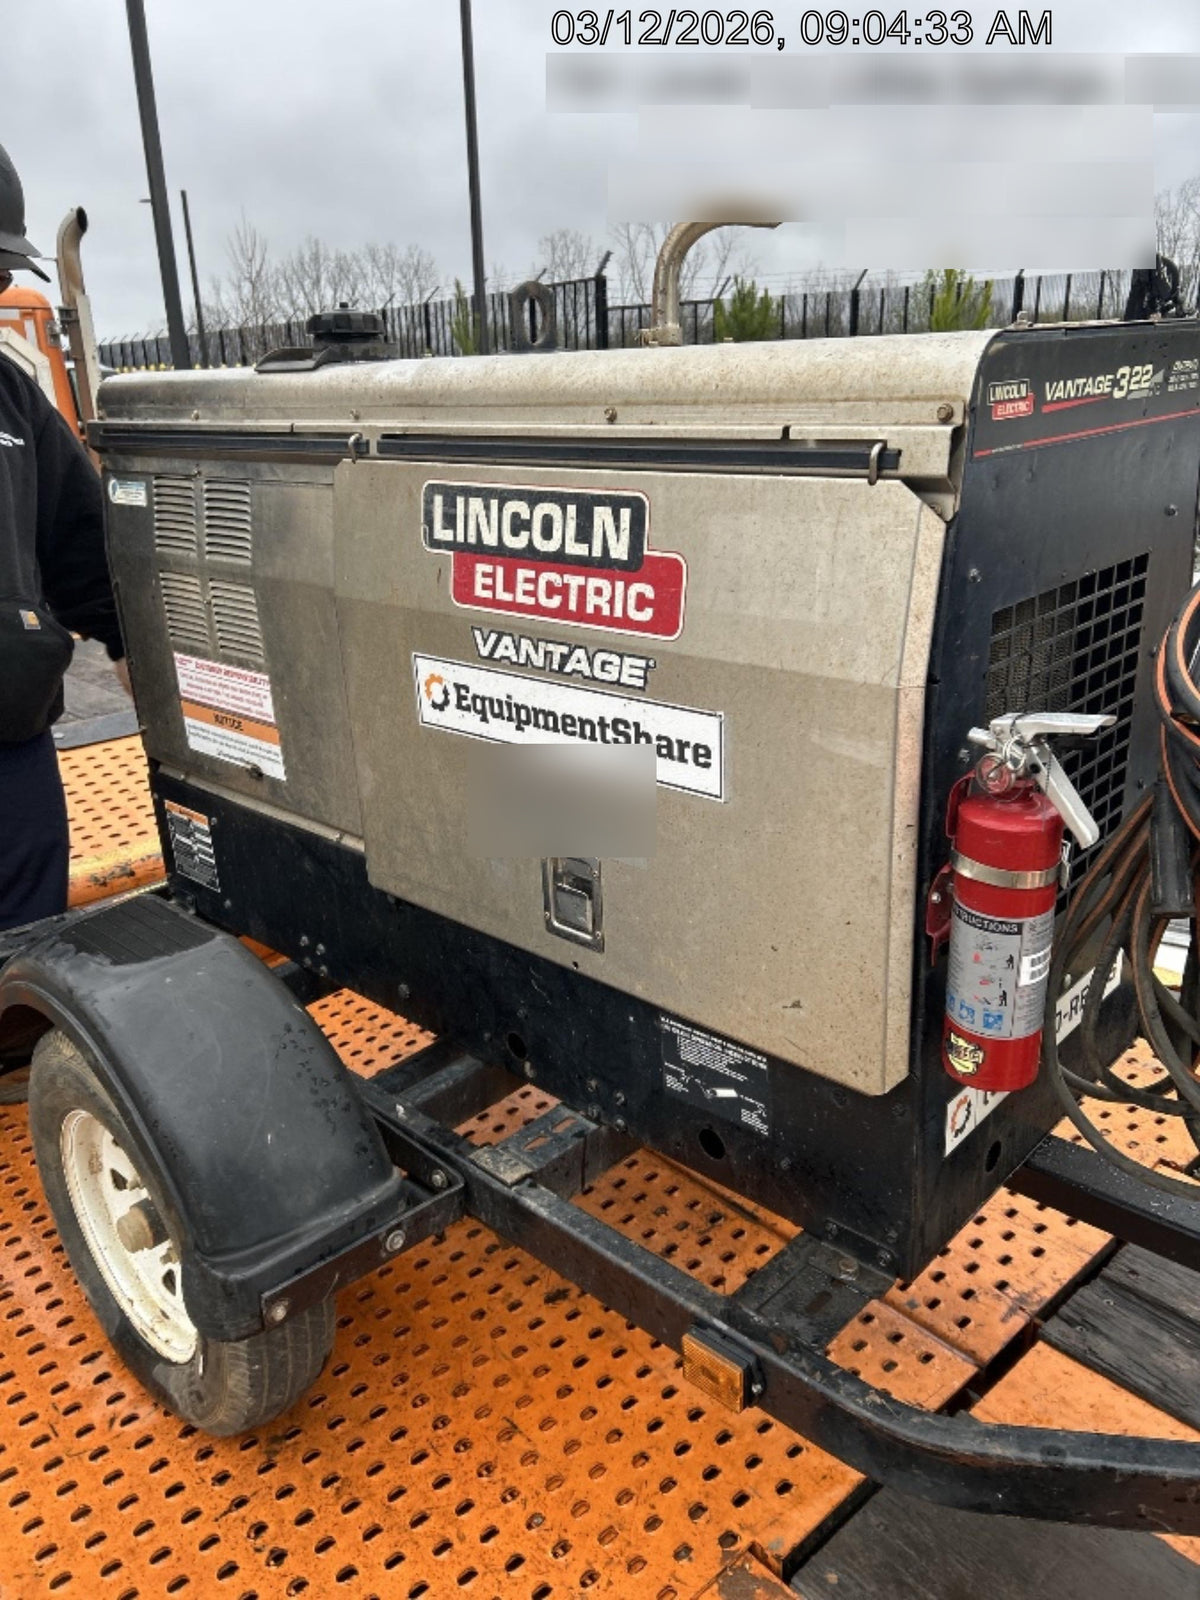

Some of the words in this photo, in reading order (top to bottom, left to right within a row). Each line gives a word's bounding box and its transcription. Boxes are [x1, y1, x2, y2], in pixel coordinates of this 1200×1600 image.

[990, 383, 1027, 402] LINCOLN
[1045, 374, 1115, 401] VANTAGE
[1113, 364, 1153, 399] 322
[997, 401, 1030, 416] ELECTRIC
[433, 494, 632, 561] LINCOLN
[474, 563, 656, 622] ELECTRIC
[453, 682, 712, 769] EquipmentShare
